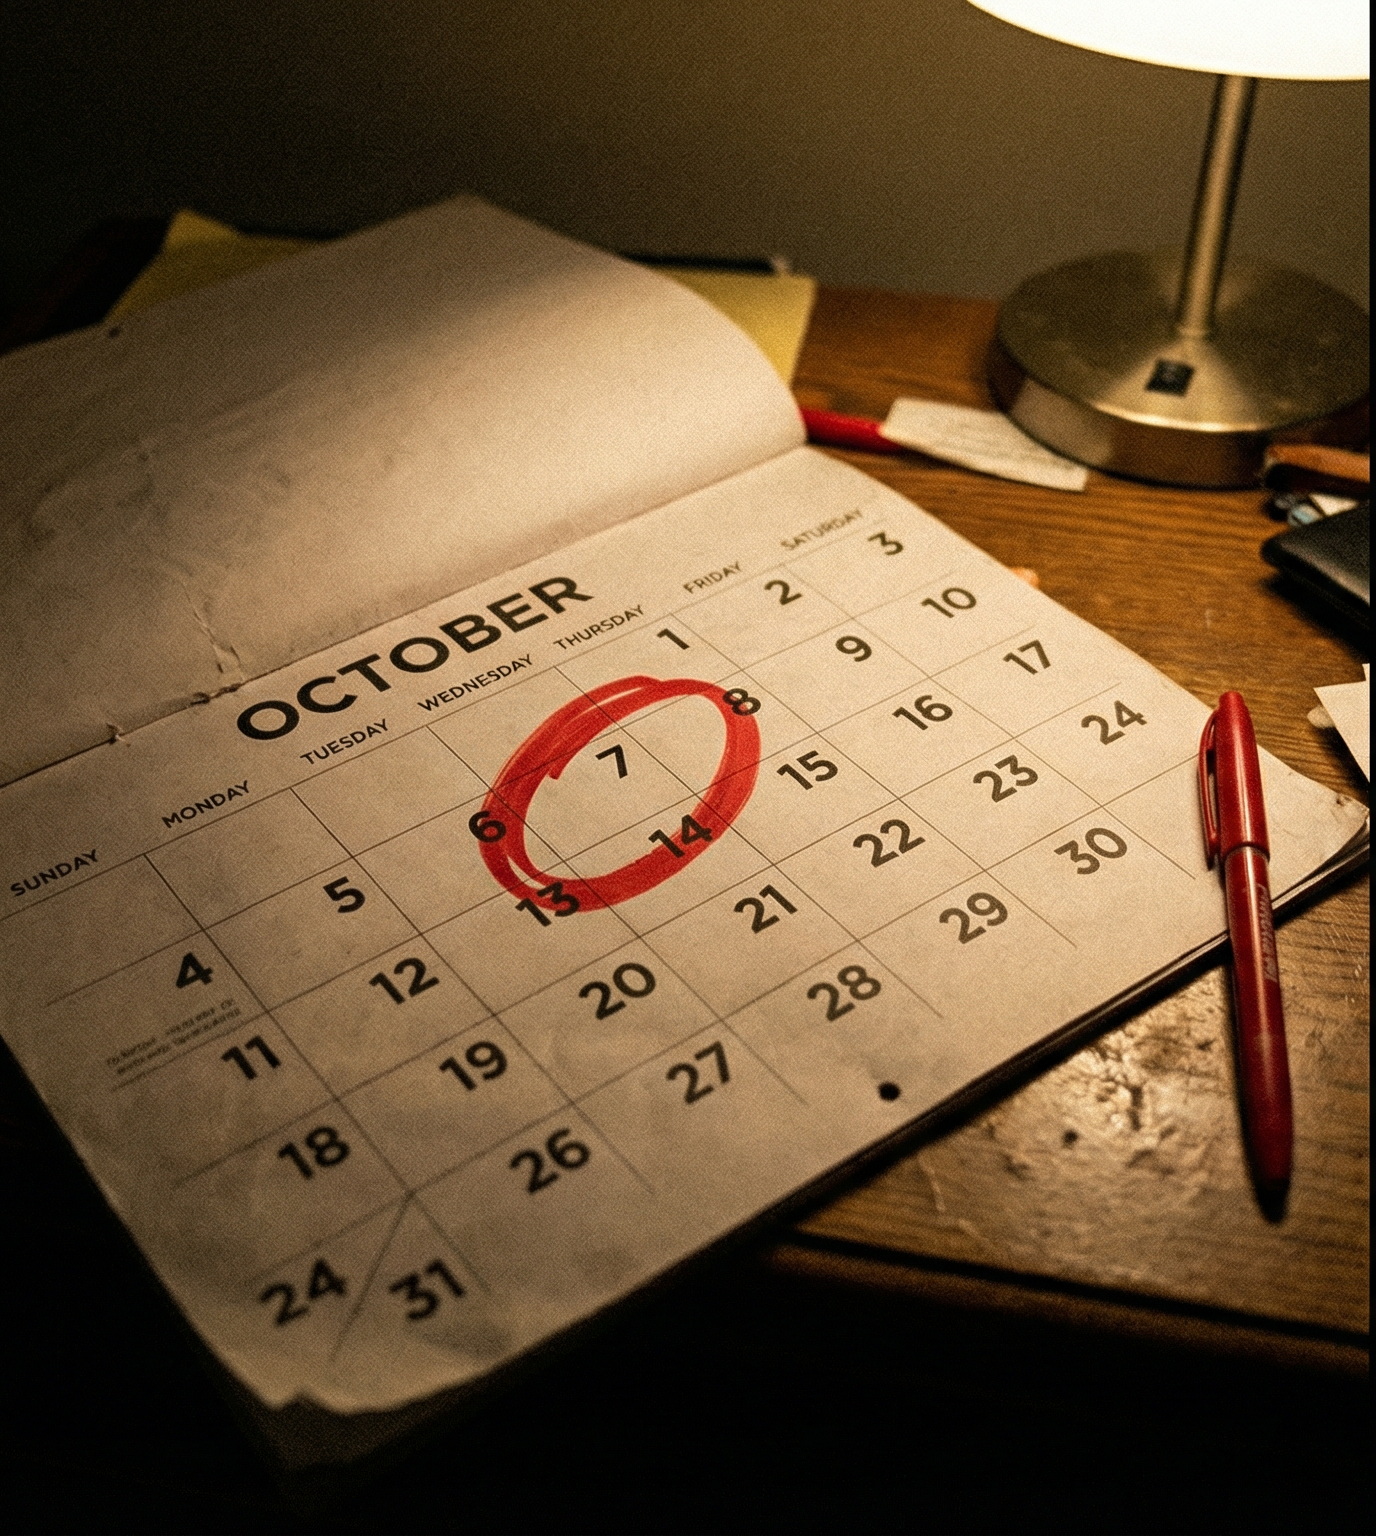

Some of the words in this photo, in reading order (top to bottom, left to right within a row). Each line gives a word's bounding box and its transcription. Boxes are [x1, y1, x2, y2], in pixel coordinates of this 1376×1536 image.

[10, 849, 99, 897] SUNDAY
[162, 780, 250, 828] MONDAY
[300, 719, 389, 765] TUESDAY
[418, 654, 533, 712] WEDNESDAY
[553, 604, 645, 651] THURSDAY
[682, 561, 742, 594] FRIDAY
[780, 508, 865, 551] SATURDAY
[176, 953, 212, 988] 4
[324, 877, 365, 913] 5
[469, 810, 506, 843] 6
[596, 744, 629, 779] 7
[723, 689, 760, 715] 8
[836, 636, 871, 662] 9
[922, 588, 976, 618] 10
[236, 577, 594, 741] OCTOBER
[657, 627, 690, 650] 1
[765, 581, 801, 605] 2
[869, 533, 903, 555] 3
[222, 1036, 280, 1080] 11
[370, 958, 439, 1004] 12
[516, 881, 580, 926] 13
[649, 815, 712, 858] 14
[777, 751, 837, 789] 15
[893, 696, 952, 730] 16
[1004, 640, 1050, 674] 17
[278, 1127, 349, 1179] 18
[440, 1042, 507, 1090] 19
[579, 963, 655, 1020] 20
[734, 885, 797, 933] 21
[853, 820, 924, 867] 22
[973, 756, 1038, 802] 23
[1082, 701, 1146, 744] 24
[259, 1259, 346, 1326] 24
[389, 1260, 465, 1321] 31
[510, 1129, 589, 1194] 26
[667, 1042, 729, 1104] 27
[807, 966, 881, 1022] 28
[940, 893, 1007, 944] 29
[1055, 828, 1127, 874] 30
